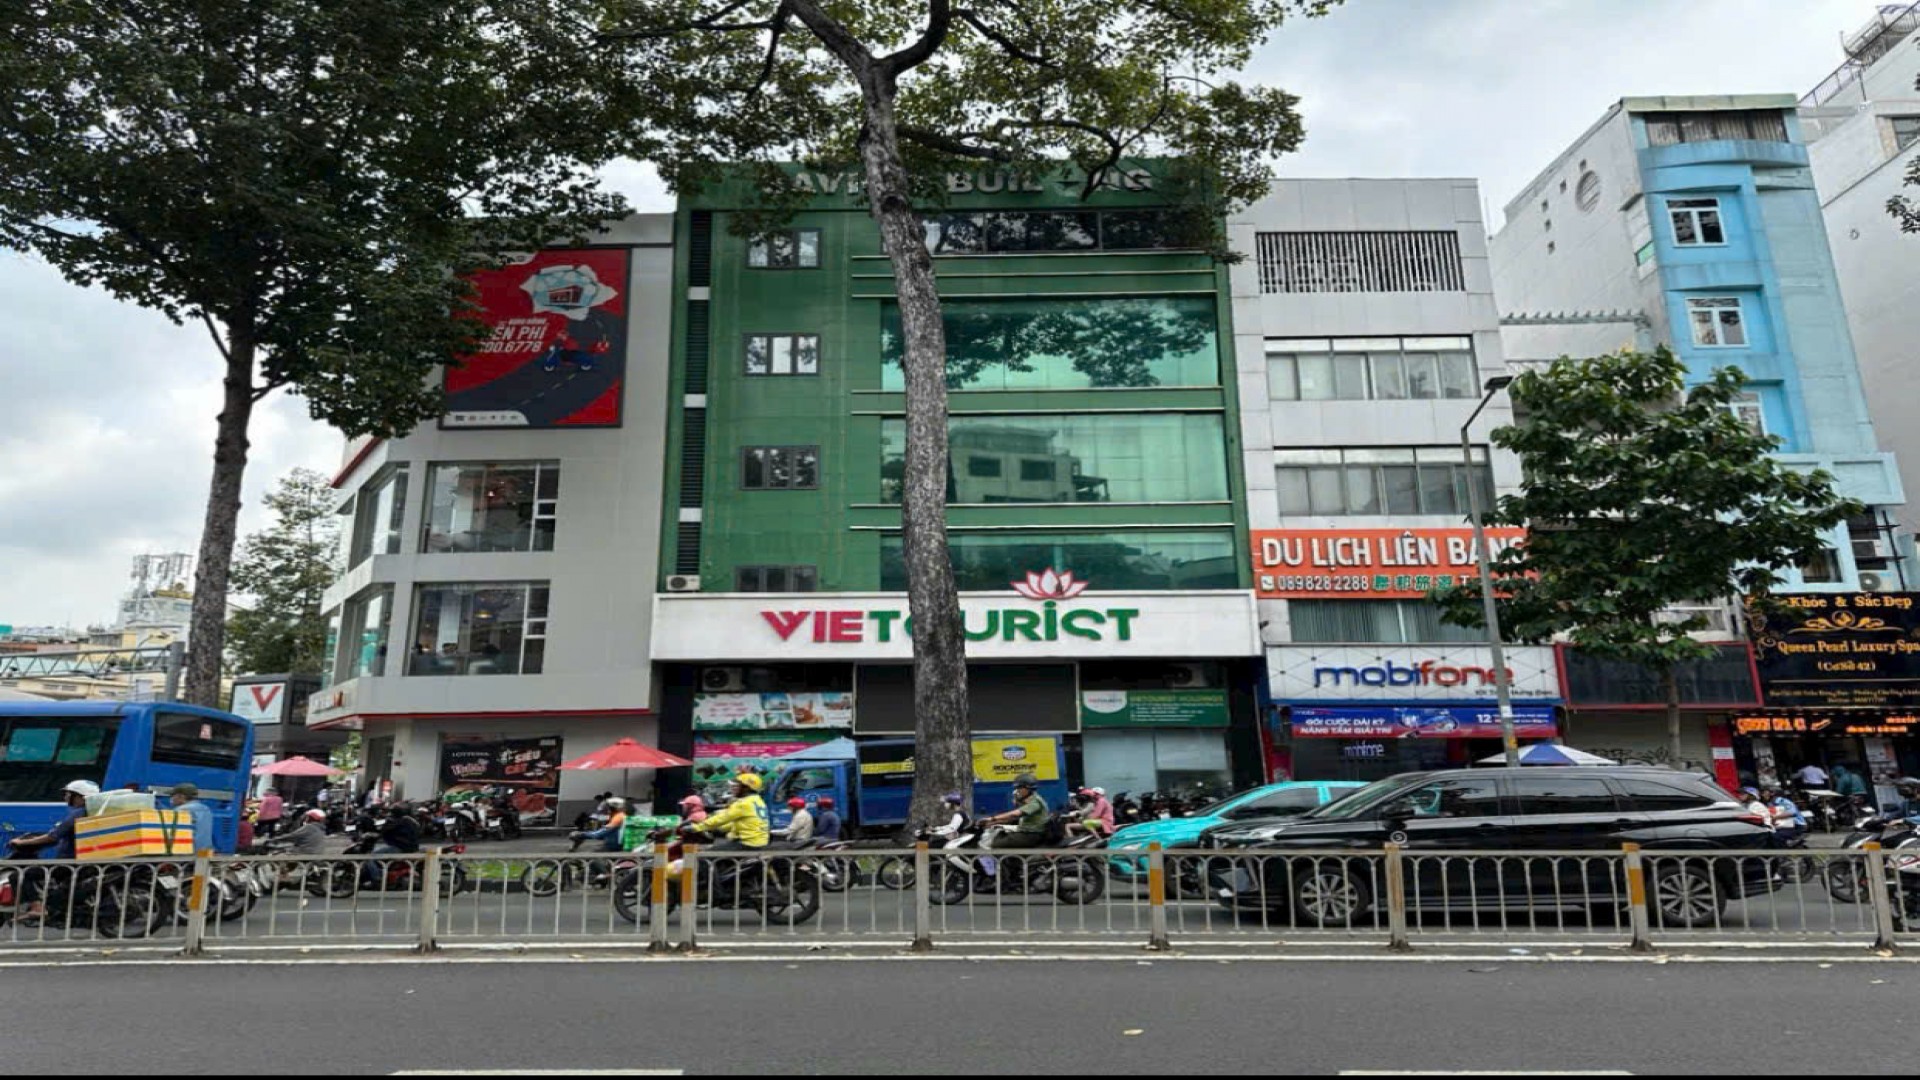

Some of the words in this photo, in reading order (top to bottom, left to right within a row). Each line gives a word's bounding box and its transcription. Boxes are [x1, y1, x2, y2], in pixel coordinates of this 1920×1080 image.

[1262, 537, 1301, 566] DU
[1311, 537, 1372, 571] LỊCH
[1379, 531, 1439, 566] LIÊN
[1835, 596, 1848, 607] &
[760, 600, 1140, 642] VIETURIST
[1777, 641, 1816, 654] Queen
[1817, 640, 1849, 652] Pearl
[1853, 639, 1896, 654] Luxury
[1314, 660, 1514, 687] mobifone
